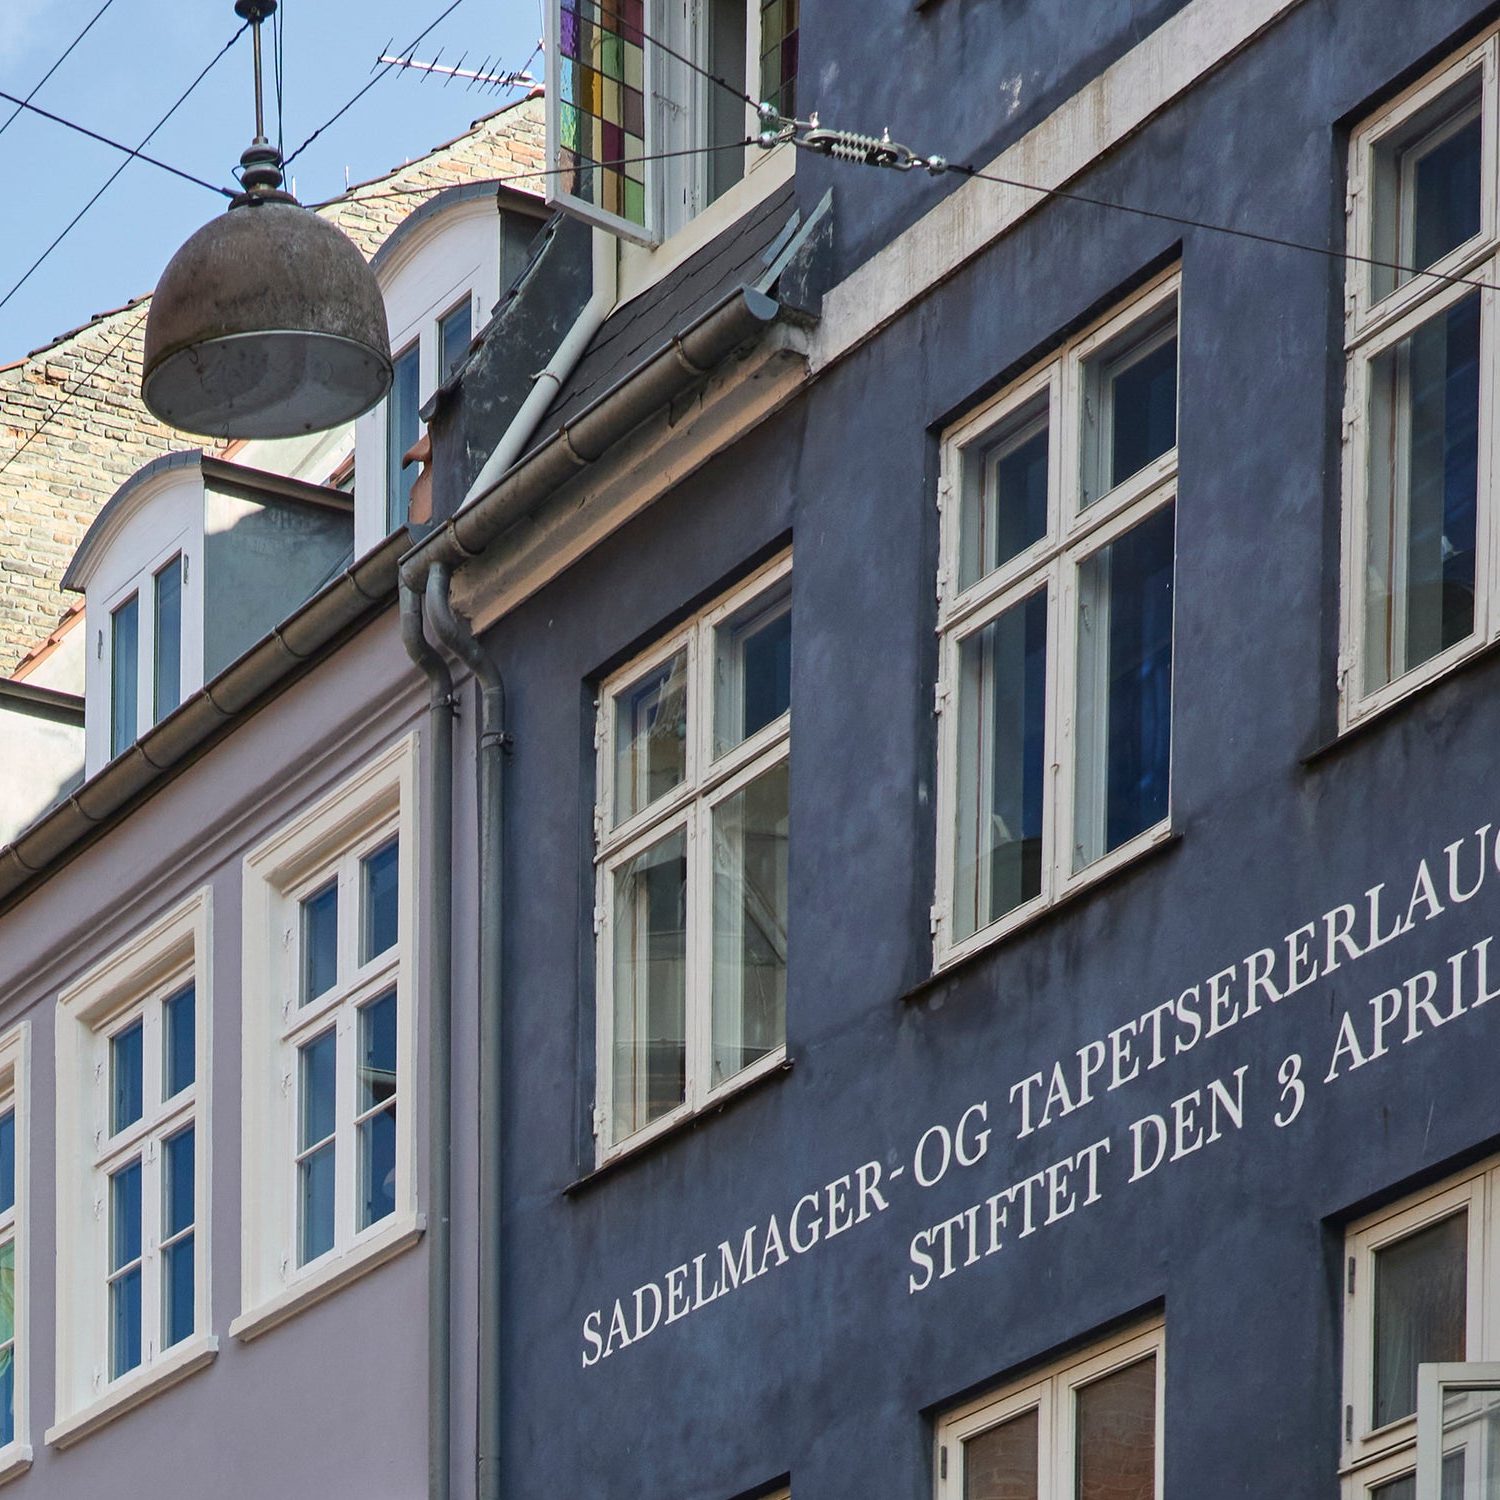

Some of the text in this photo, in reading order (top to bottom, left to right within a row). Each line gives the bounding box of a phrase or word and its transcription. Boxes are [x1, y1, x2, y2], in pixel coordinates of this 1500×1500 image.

[910, 935, 1500, 1295] STIFTET DEN 3 APRIL
[1009, 823, 1500, 1140] TAPETSERERLAU
